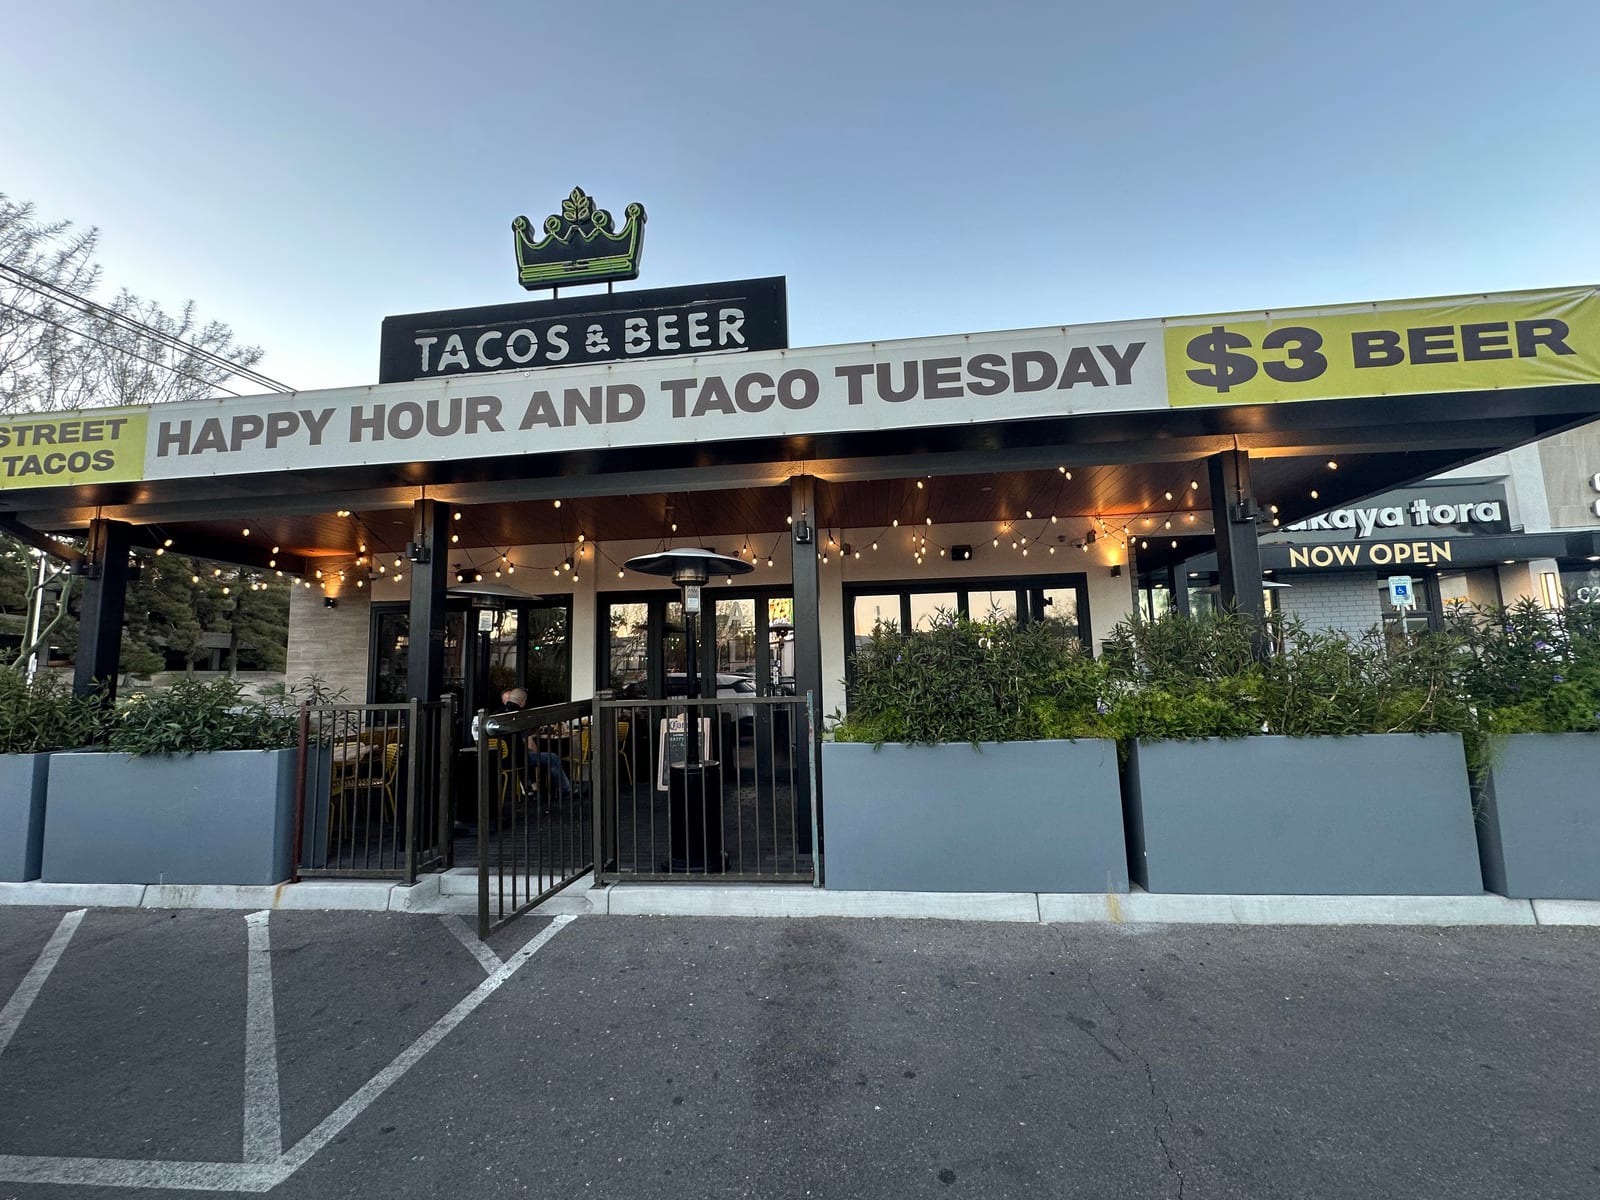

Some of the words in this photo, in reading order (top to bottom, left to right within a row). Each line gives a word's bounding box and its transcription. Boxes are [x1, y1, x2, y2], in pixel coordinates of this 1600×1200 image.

[414, 325, 570, 372] TACOS
[585, 324, 611, 354] &
[624, 308, 746, 354] BEER
[1186, 326, 1327, 393] $3
[1351, 319, 1578, 368] BEER
[157, 408, 336, 457] HAPPY
[349, 396, 506, 443] HOUR
[519, 384, 645, 430] AND
[660, 369, 819, 418] TACO
[835, 342, 1146, 405] TUESDAY
[2, 449, 115, 477] TACOS
[1411, 498, 1502, 526] tora
[1289, 545, 1361, 568] NOW
[1369, 542, 1452, 566] OPEN
